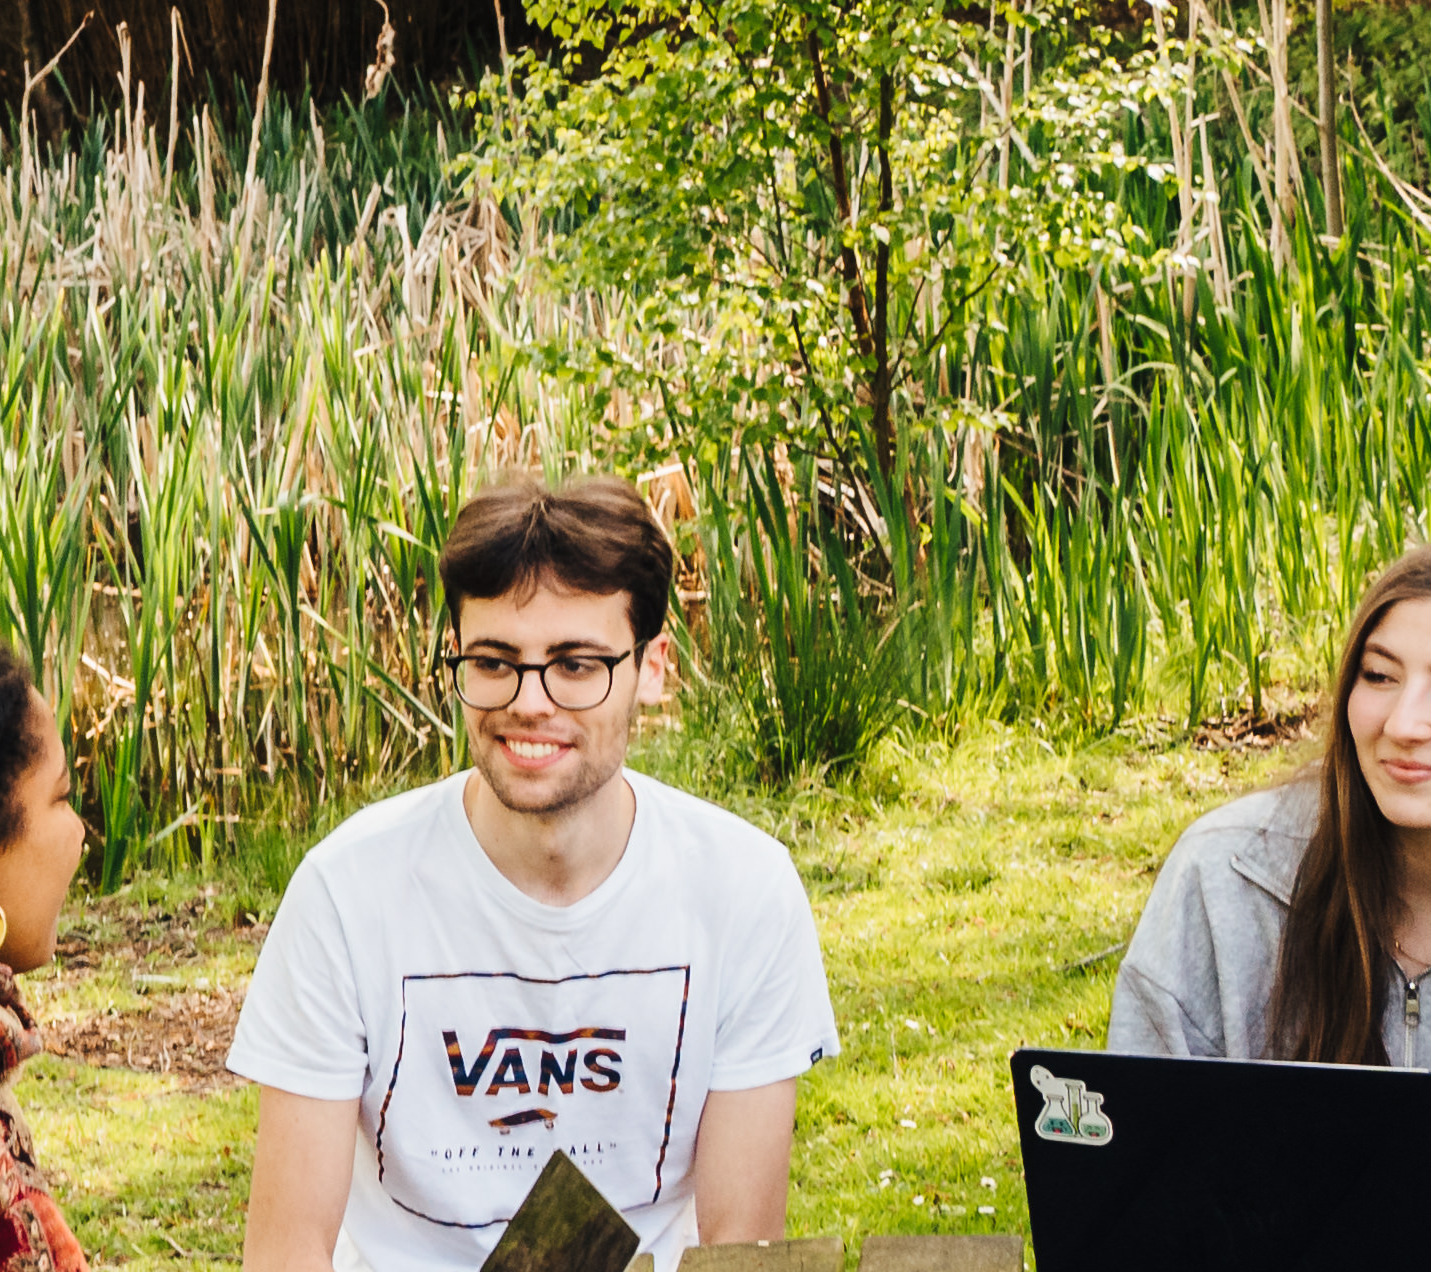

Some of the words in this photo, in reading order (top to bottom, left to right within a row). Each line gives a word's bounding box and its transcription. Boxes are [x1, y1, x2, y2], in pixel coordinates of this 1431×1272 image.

[442, 1028, 626, 1096] VANS
[498, 1144, 535, 1159] THE
[567, 1141, 617, 1156] ALL"
